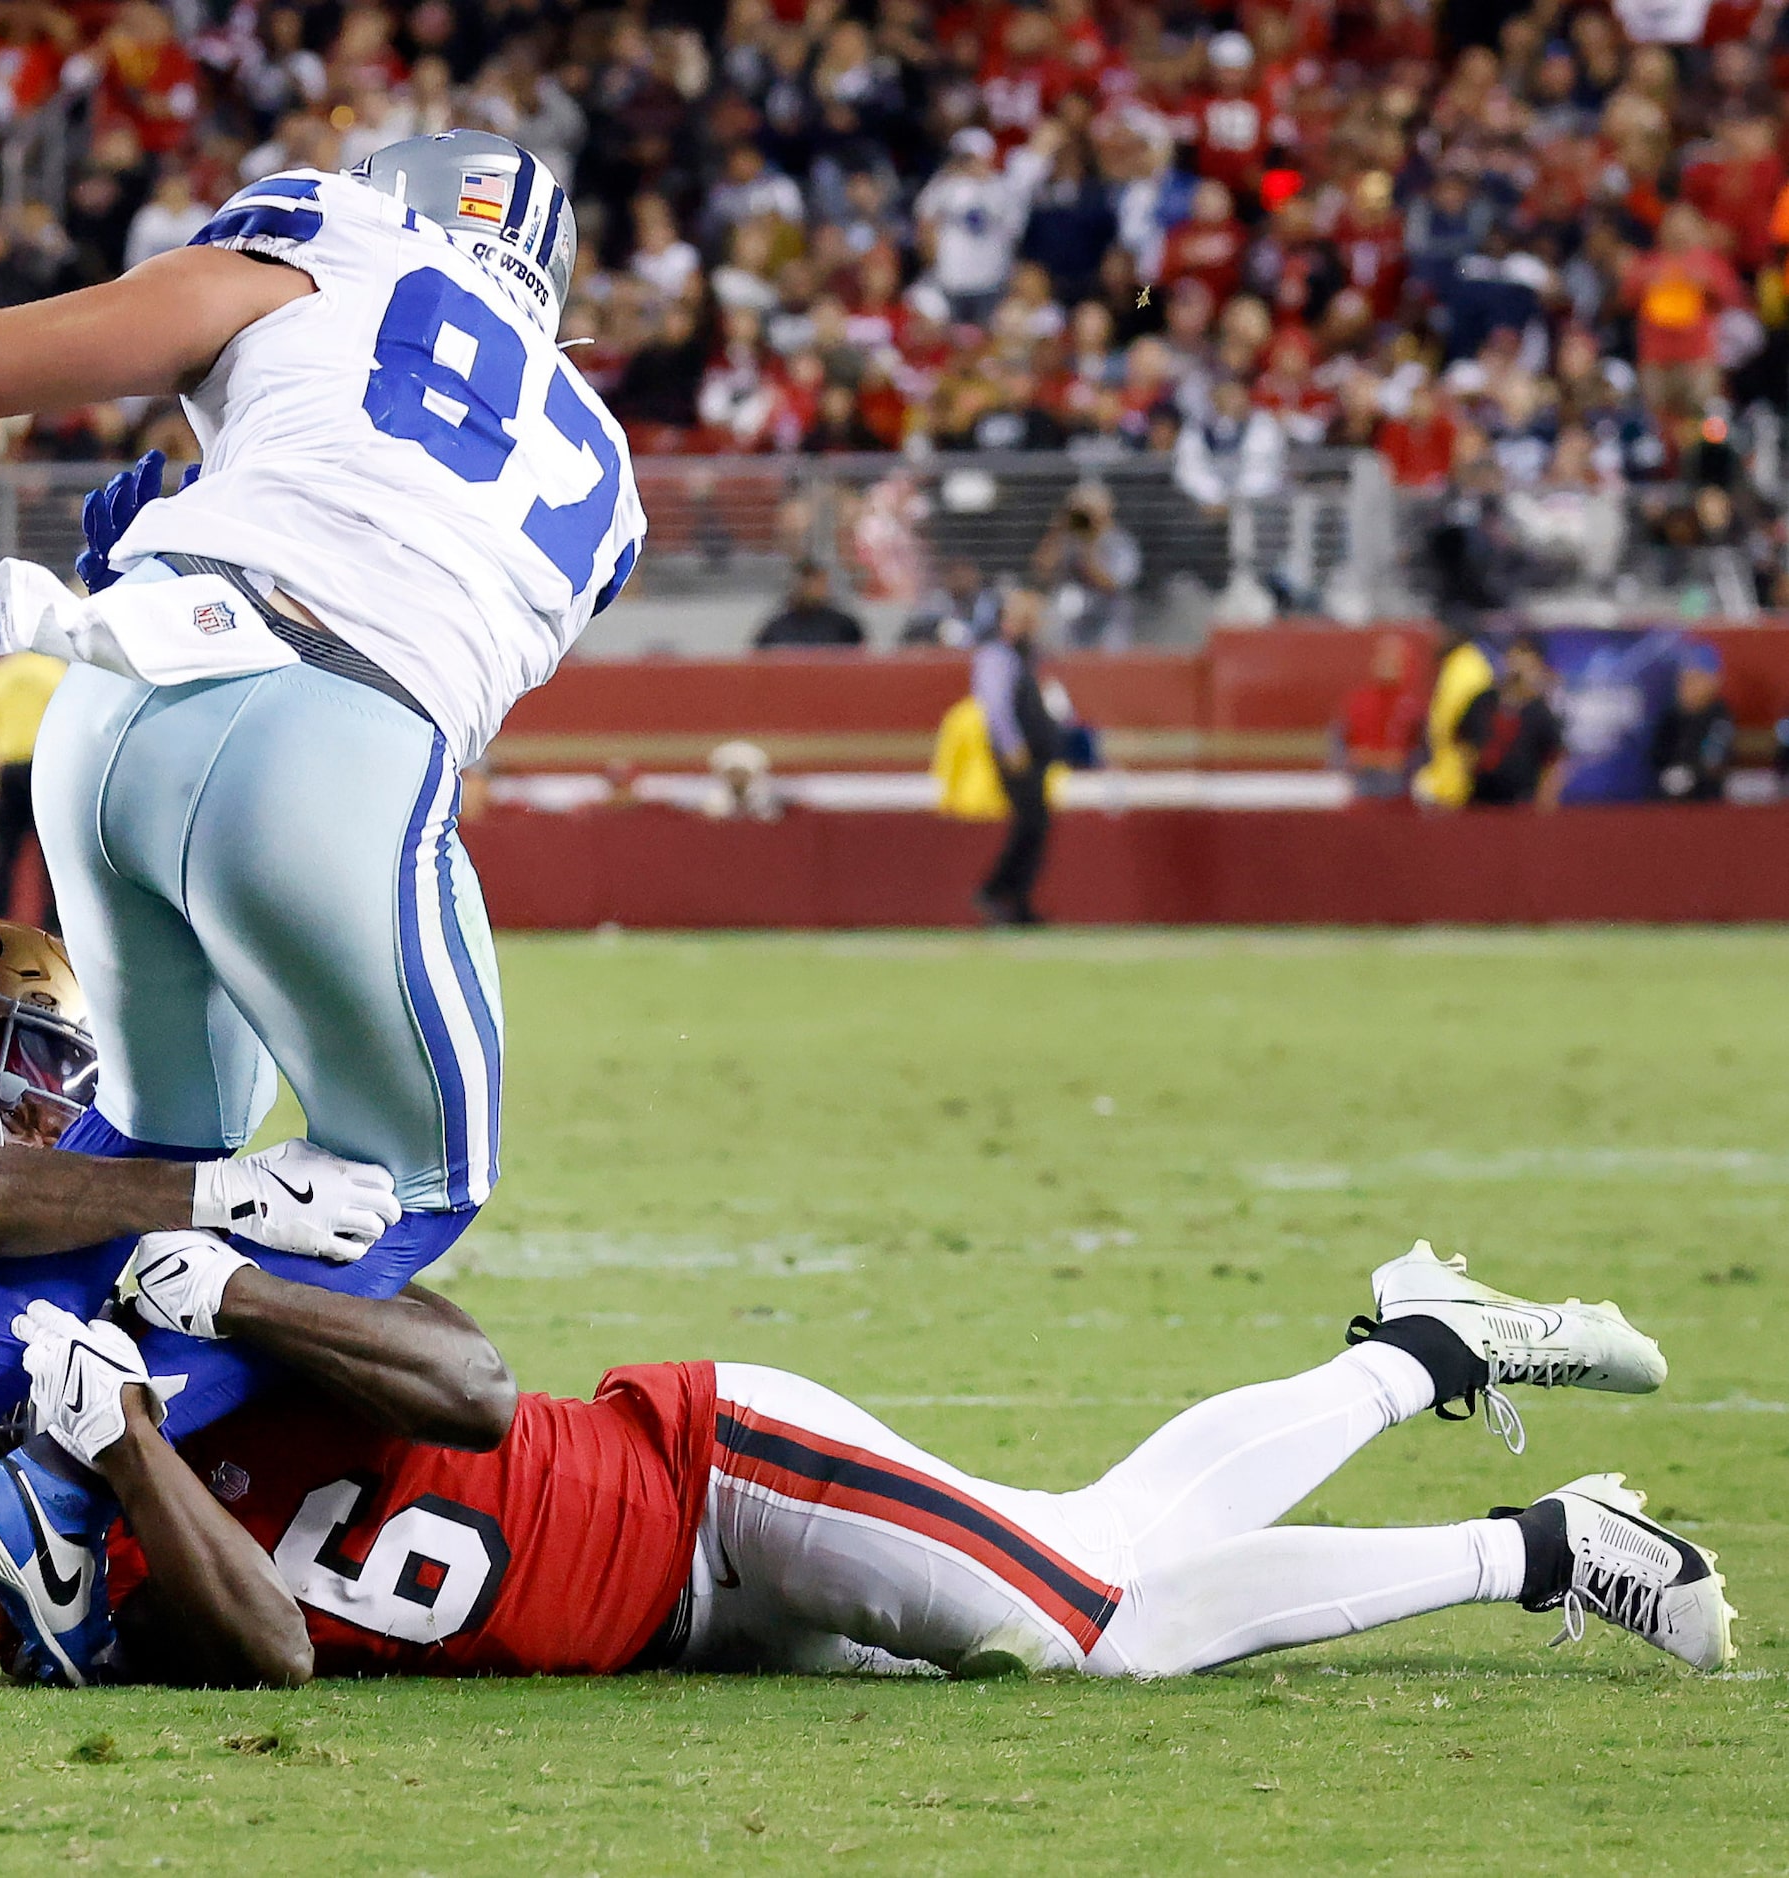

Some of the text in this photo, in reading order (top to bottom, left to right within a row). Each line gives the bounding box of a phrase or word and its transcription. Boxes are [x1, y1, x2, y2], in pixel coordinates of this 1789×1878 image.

[472, 242, 549, 307] COWBOYS
[362, 266, 621, 597] 87
[273, 1478, 496, 1645] 6
